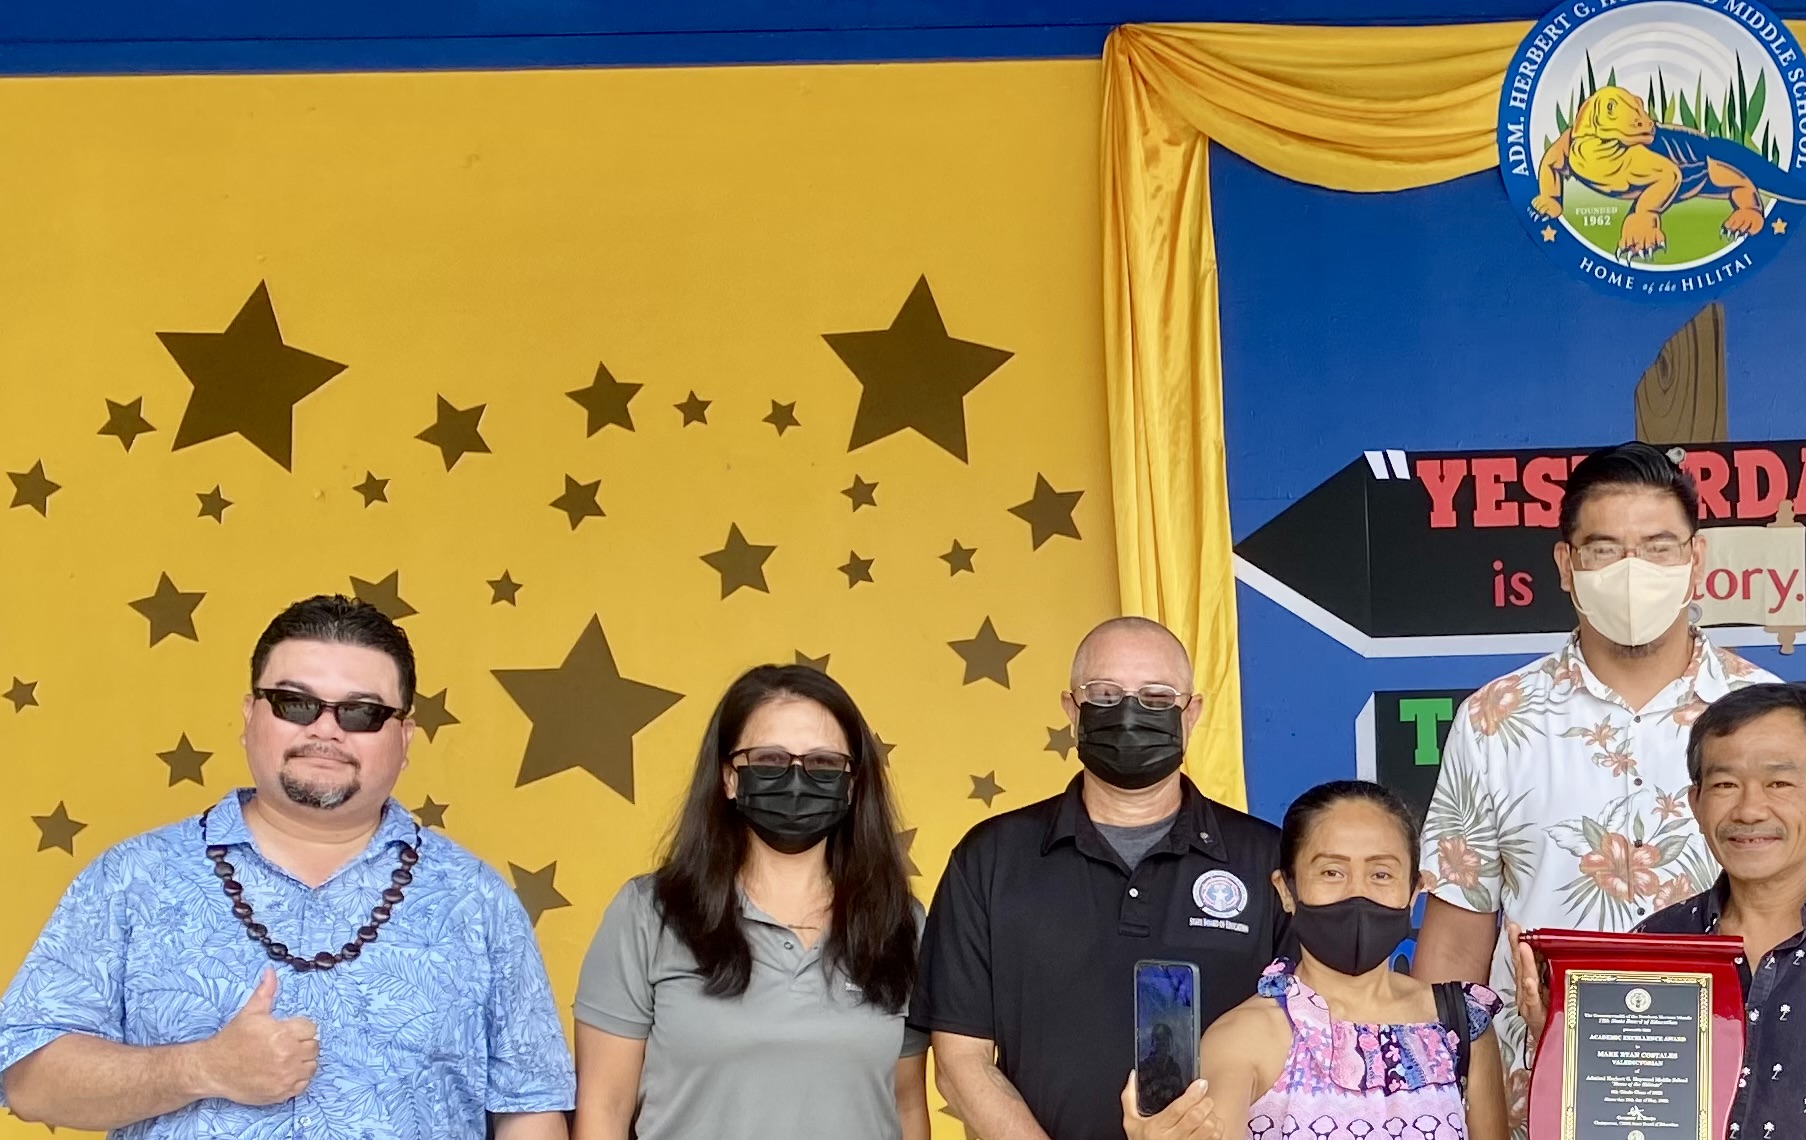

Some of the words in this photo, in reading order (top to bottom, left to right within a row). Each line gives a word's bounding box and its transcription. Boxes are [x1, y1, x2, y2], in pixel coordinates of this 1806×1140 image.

[1573, 2, 1596, 18] G.
[1723, 0, 1797, 67] MIDDLE
[1510, 12, 1572, 110] HERBERT
[1506, 115, 1530, 177] ADM.
[1575, 206, 1618, 216] FOUNDED
[1583, 215, 1611, 227] 1962
[1579, 256, 1635, 290] HOME
[1642, 280, 1654, 295] of
[1658, 279, 1677, 293] the
[1681, 252, 1753, 292] HILITAI
[1492, 559, 1534, 608] is
